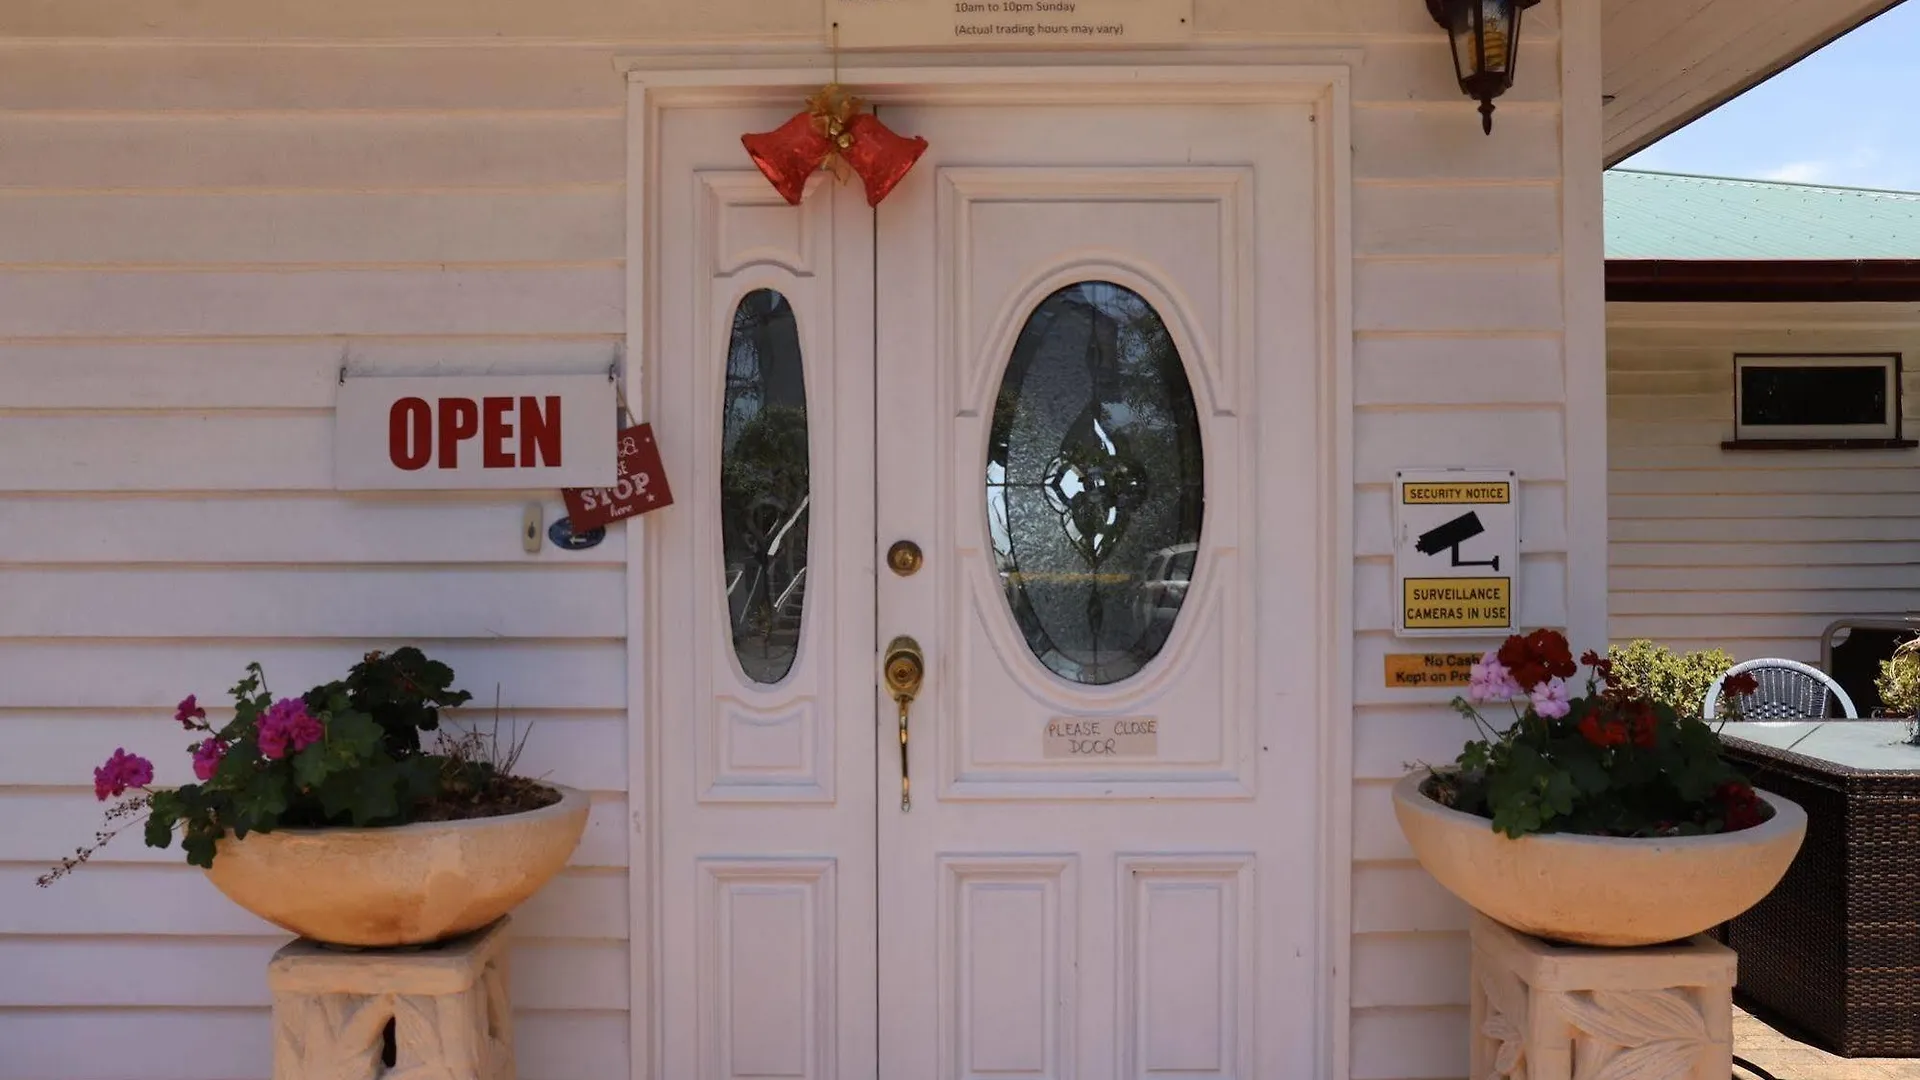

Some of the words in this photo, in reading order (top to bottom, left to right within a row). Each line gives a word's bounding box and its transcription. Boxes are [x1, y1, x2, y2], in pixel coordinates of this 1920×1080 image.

[955, 2, 985, 13] 10am
[988, 2, 1000, 12] to
[1003, 1, 1034, 14] 10pm
[1036, 1, 1076, 13] Sunday
[955, 24, 993, 36] (Actual
[996, 23, 1035, 36] trading
[1038, 23, 1069, 34] hours
[1071, 25, 1095, 35] may
[1097, 24, 1124, 36] vary)
[389, 396, 562, 471] OPEN
[580, 471, 650, 512] STOP
[1410, 488, 1461, 499] SECURITY
[1466, 488, 1504, 499] NOTICE
[1413, 588, 1501, 600] SURVEILLANCE
[1407, 608, 1463, 620] CAMERAS
[1468, 607, 1479, 619] IN
[1484, 607, 1506, 619] USE
[1424, 654, 1443, 667] No
[1446, 653, 1481, 667] Cash
[1396, 671, 1427, 685] Kept
[1430, 672, 1447, 683] on
[1450, 670, 1472, 682] Pre
[1048, 722, 1101, 737] PLEASE
[1114, 720, 1157, 735] CLOSE
[1068, 738, 1116, 754] DOOR
